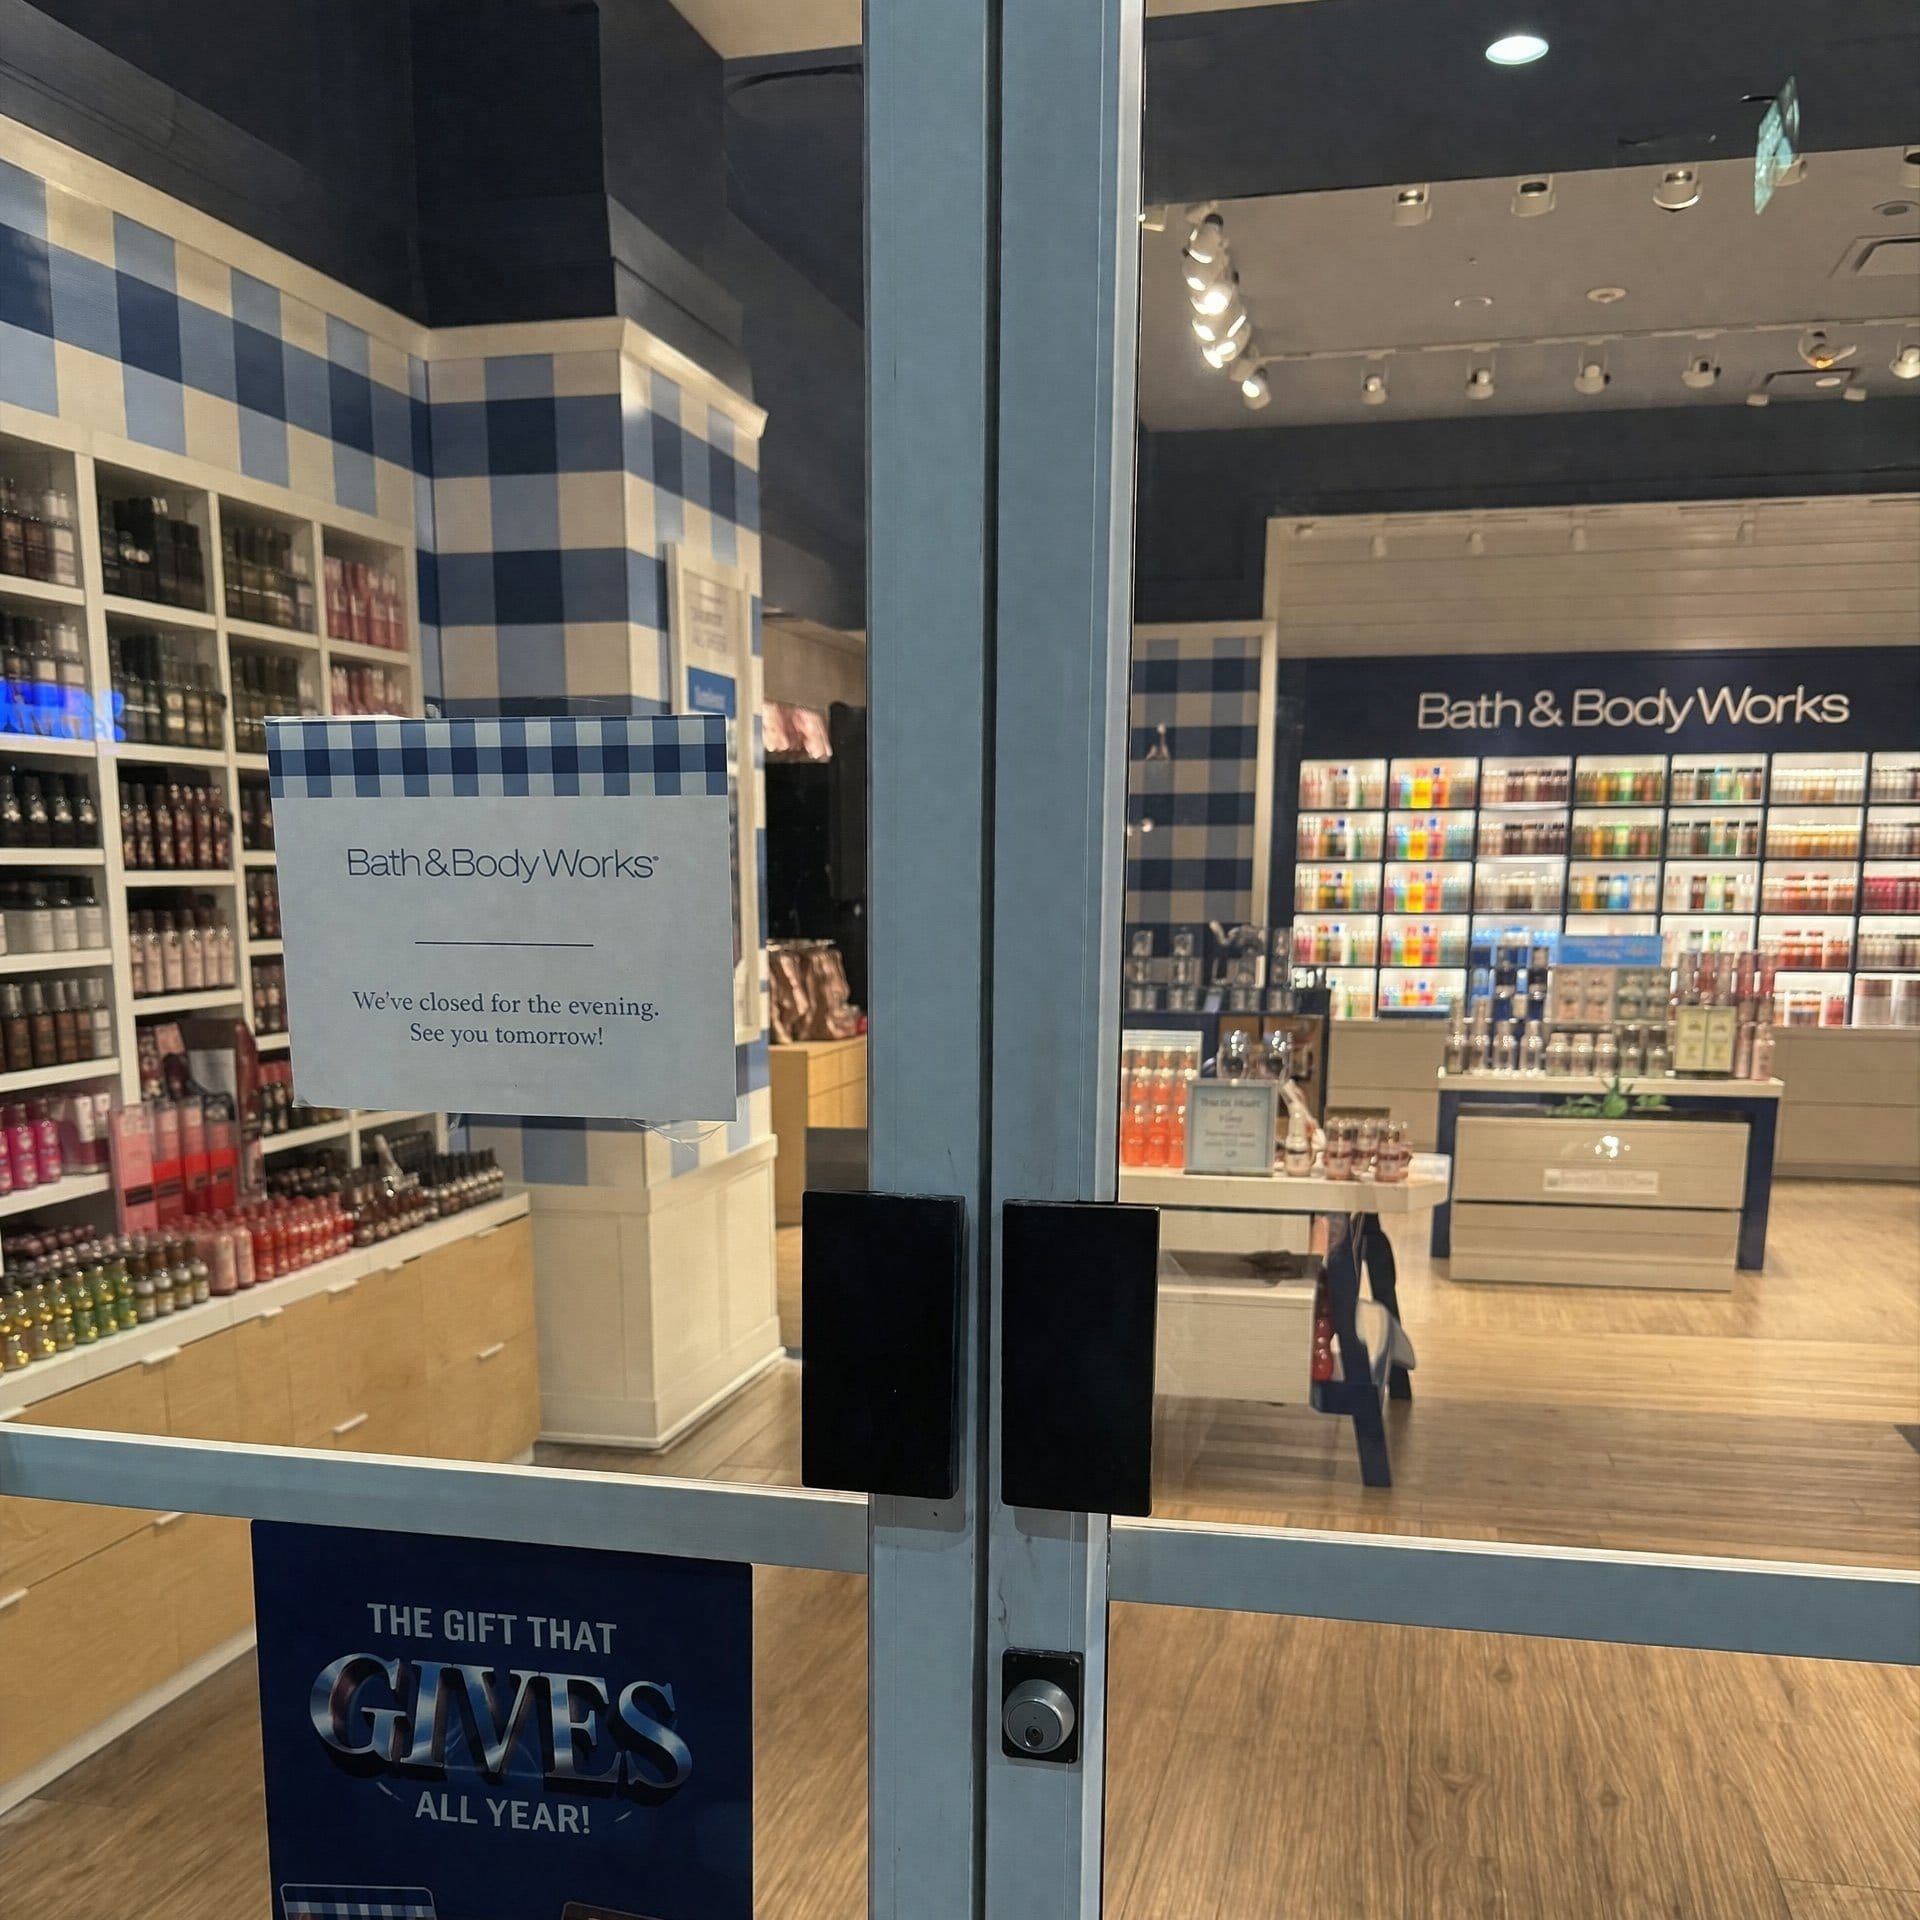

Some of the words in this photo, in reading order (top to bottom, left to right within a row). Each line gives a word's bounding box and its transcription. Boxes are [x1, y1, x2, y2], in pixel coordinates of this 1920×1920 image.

[1417, 691, 1523, 730] Bath
[1528, 689, 1564, 728] &
[352, 991, 413, 1011] We've
[419, 992, 485, 1013] closed
[490, 993, 521, 1013] for
[527, 994, 562, 1014] the
[568, 997, 660, 1022] evening.
[410, 1023, 445, 1042] See
[450, 1028, 489, 1048] you
[495, 1026, 604, 1046] tomorrow!
[366, 1602, 433, 1639] THE
[443, 1609, 518, 1645] GIFT
[527, 1615, 617, 1654] THAT
[309, 1652, 694, 1792] GIVES
[415, 1790, 478, 1825] ALL
[486, 1797, 591, 1835] YEAR!
